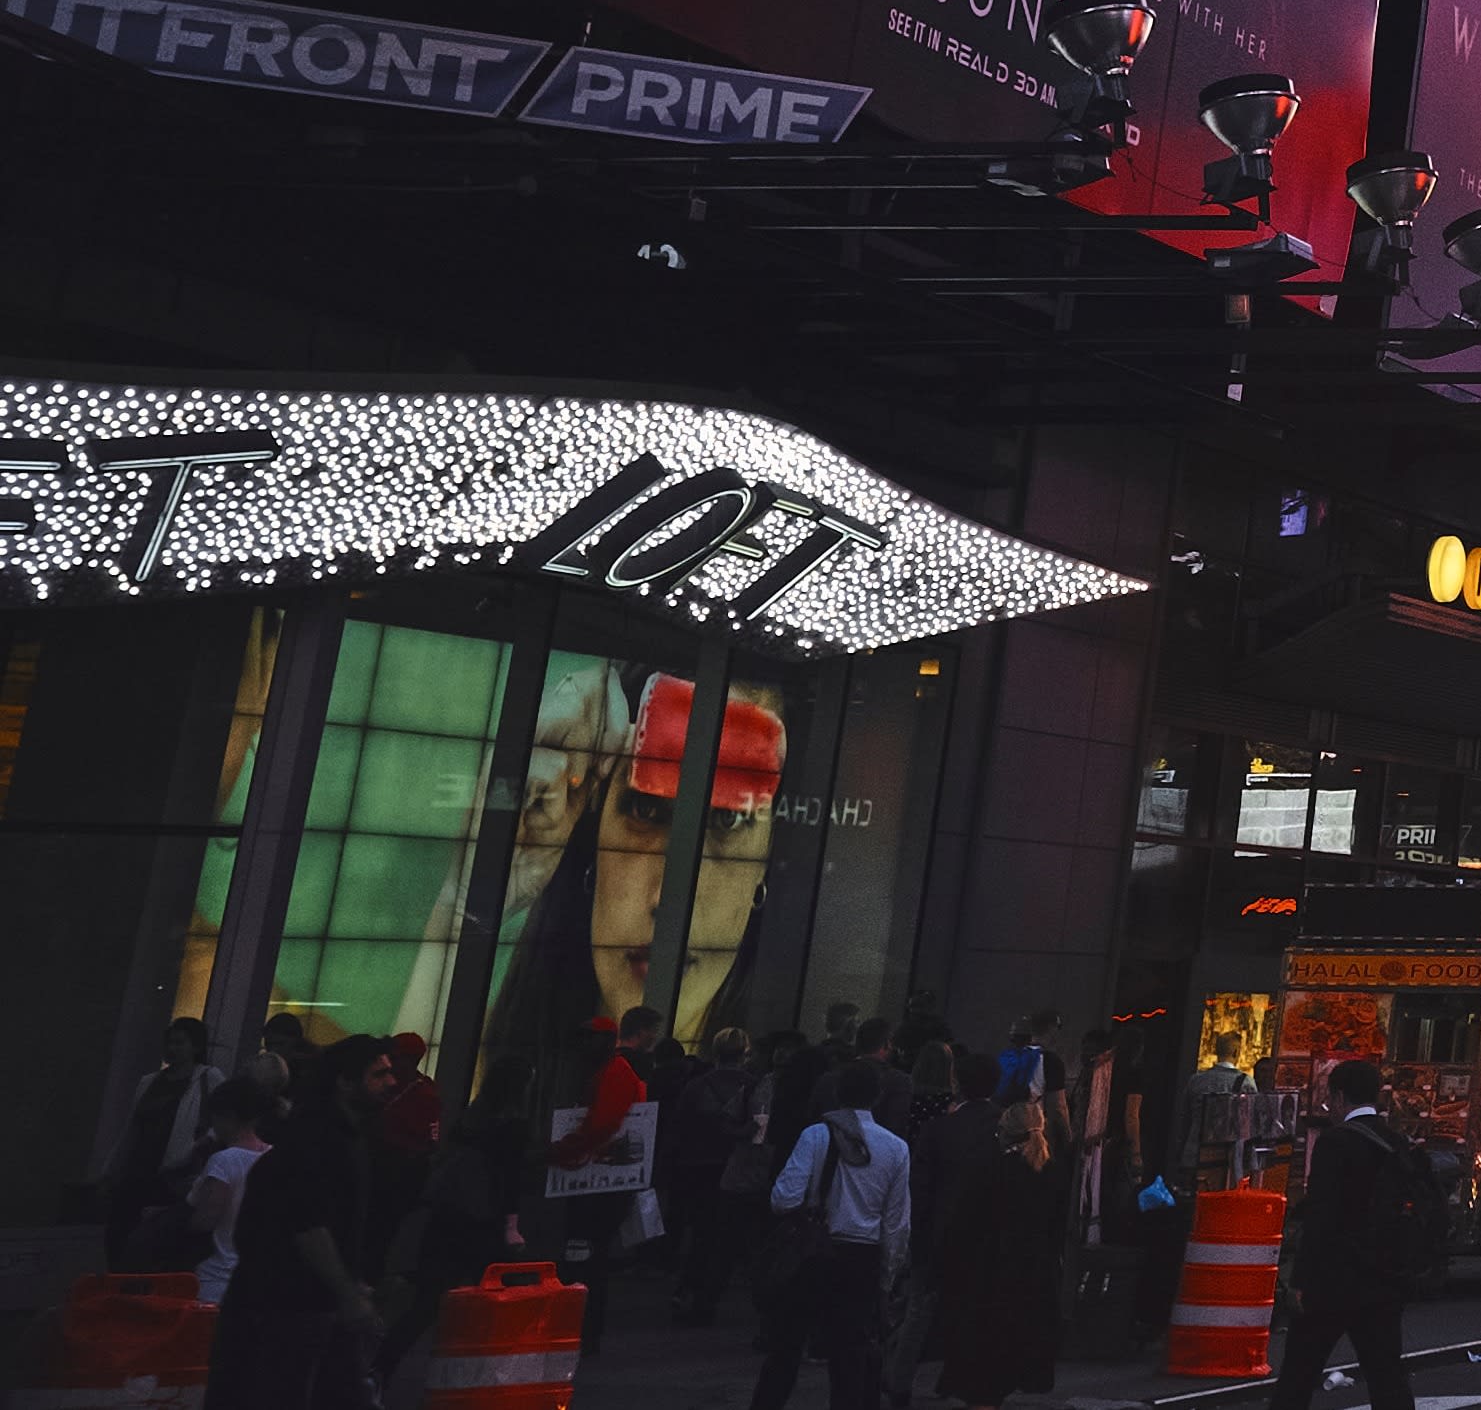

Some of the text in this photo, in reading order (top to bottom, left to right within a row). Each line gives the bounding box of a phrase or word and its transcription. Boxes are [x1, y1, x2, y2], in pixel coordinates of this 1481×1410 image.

[887, 7, 913, 39] SEE
[913, 17, 927, 44] IT
[926, 25, 942, 53] IN
[1013, 70, 1039, 98] 3D
[1039, 82, 1058, 110] AN
[1234, 16, 1269, 63] HER
[571, 65, 831, 143] PRIME
[520, 453, 884, 622] LOFT
[1294, 964, 1380, 980] HALAL
